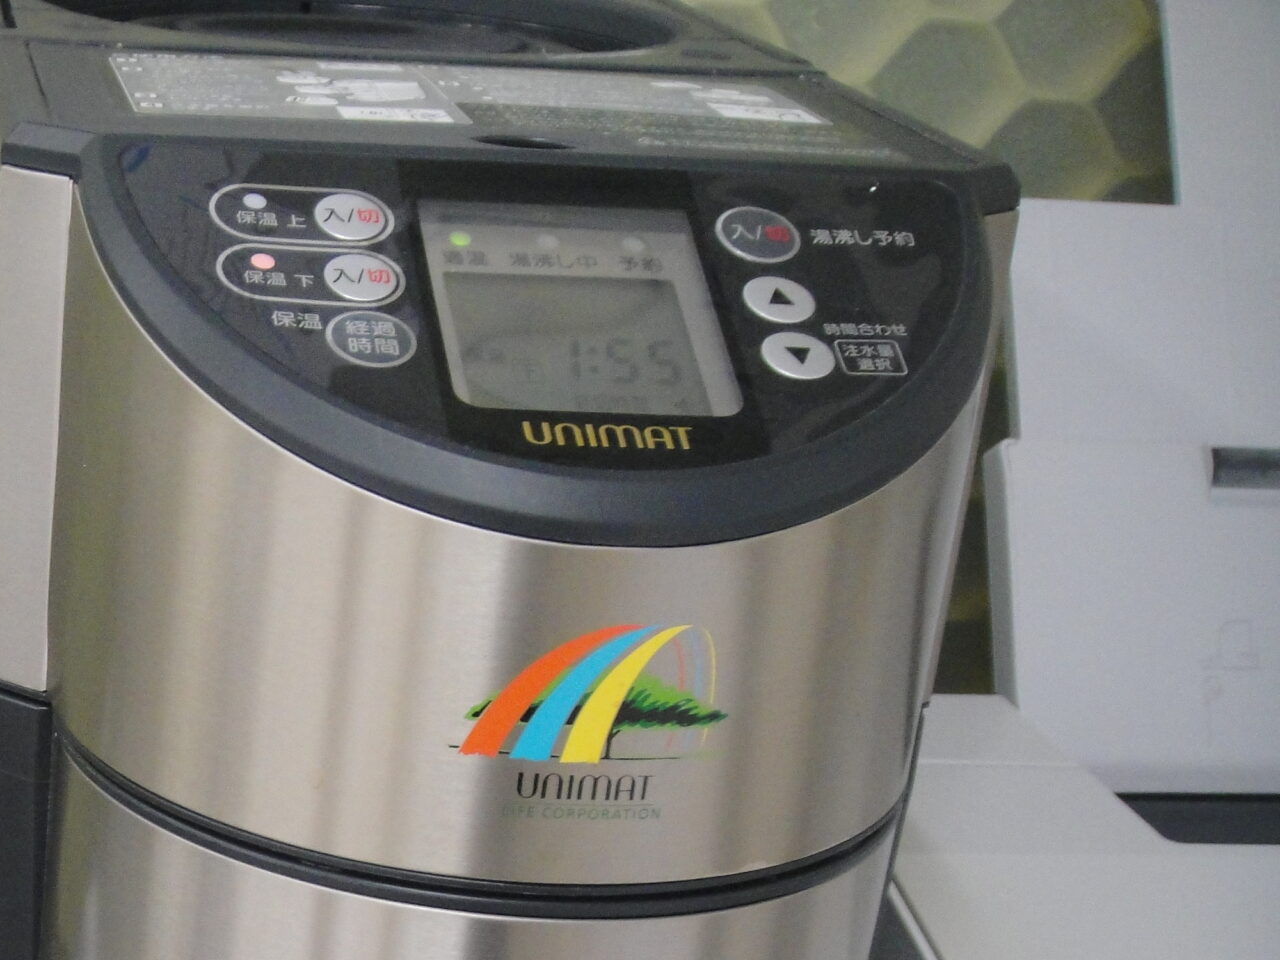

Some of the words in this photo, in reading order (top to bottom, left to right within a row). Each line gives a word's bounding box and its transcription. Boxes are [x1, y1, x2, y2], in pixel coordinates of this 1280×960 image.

[271, 310, 323, 331] 保温
[347, 337, 400, 356] 時間
[521, 420, 694, 451] UNIMAT
[516, 772, 657, 801] UNIMAT
[541, 806, 662, 821] CORPORATION
